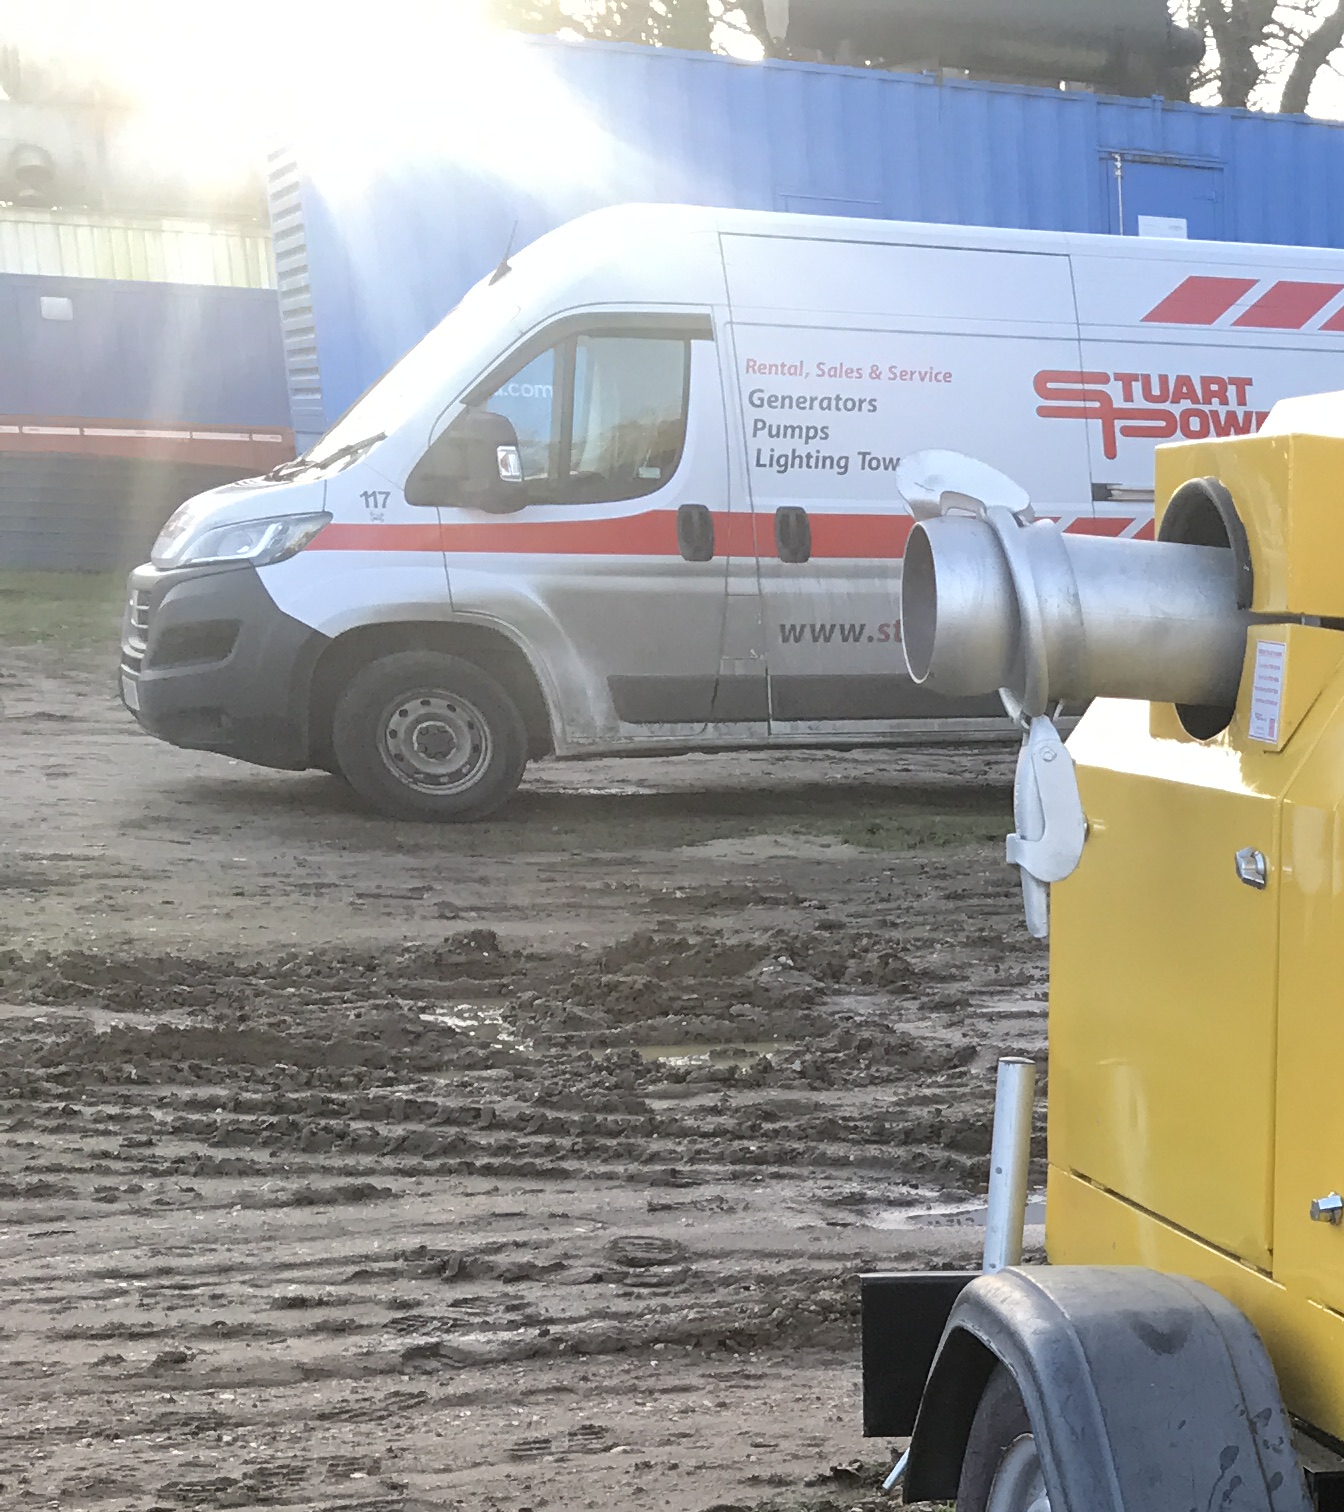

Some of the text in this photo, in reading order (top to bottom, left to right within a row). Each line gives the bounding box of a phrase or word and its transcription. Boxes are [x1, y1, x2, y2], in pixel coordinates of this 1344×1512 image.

[745, 358, 953, 383] Rental, Sales & Service
[748, 388, 878, 413] Generators
[1033, 370, 1253, 408] STUART
[752, 418, 830, 444] Pumps
[755, 448, 900, 476] Lighting Tow
[359, 490, 391, 508] 117
